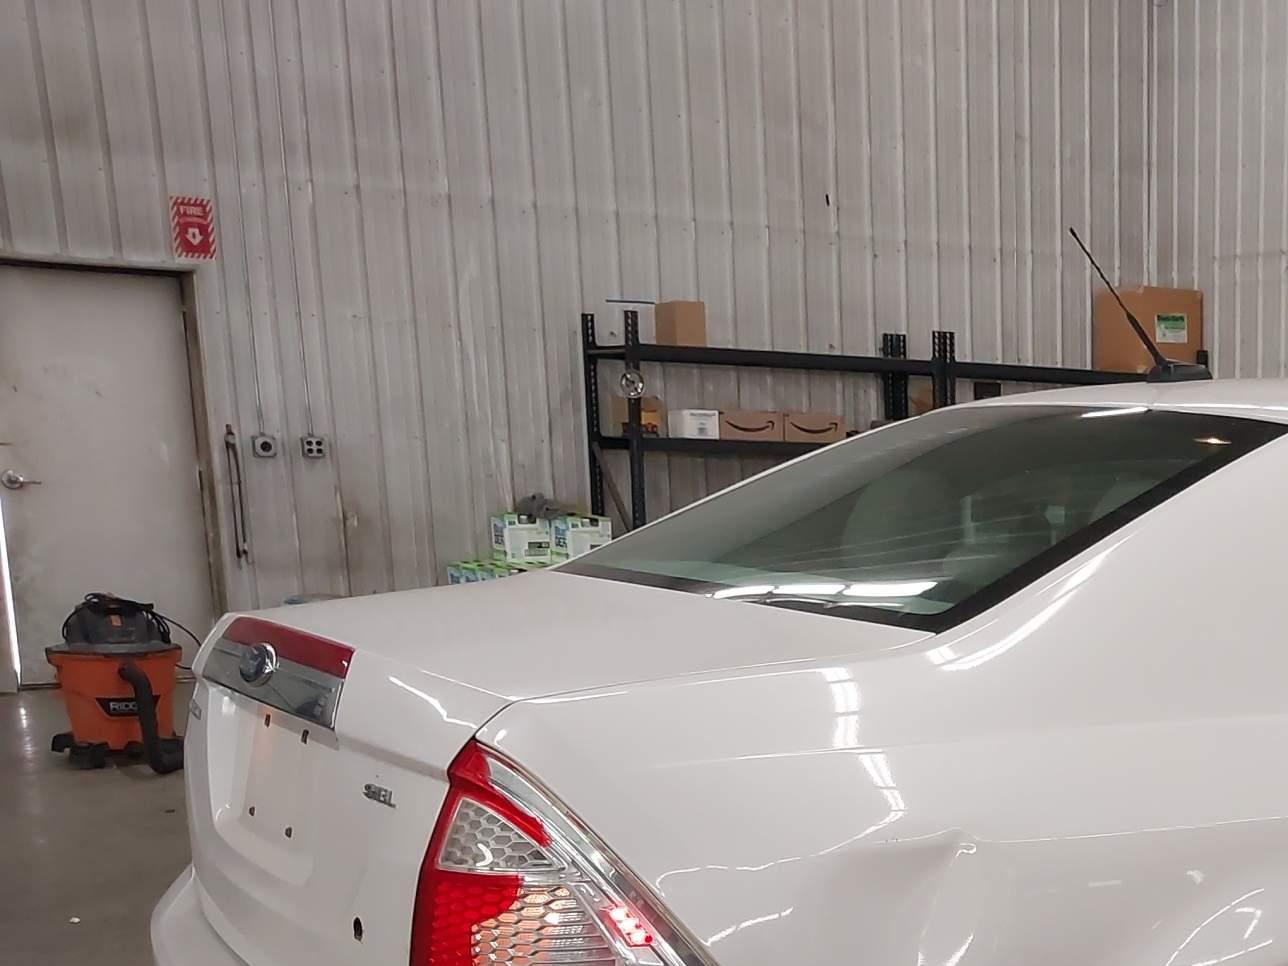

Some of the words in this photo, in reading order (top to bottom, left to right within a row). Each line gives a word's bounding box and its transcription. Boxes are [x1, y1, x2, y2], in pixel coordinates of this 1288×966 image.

[179, 205, 205, 216] FIRE
[109, 701, 138, 713] RIDG
[362, 783, 397, 809] SEL
